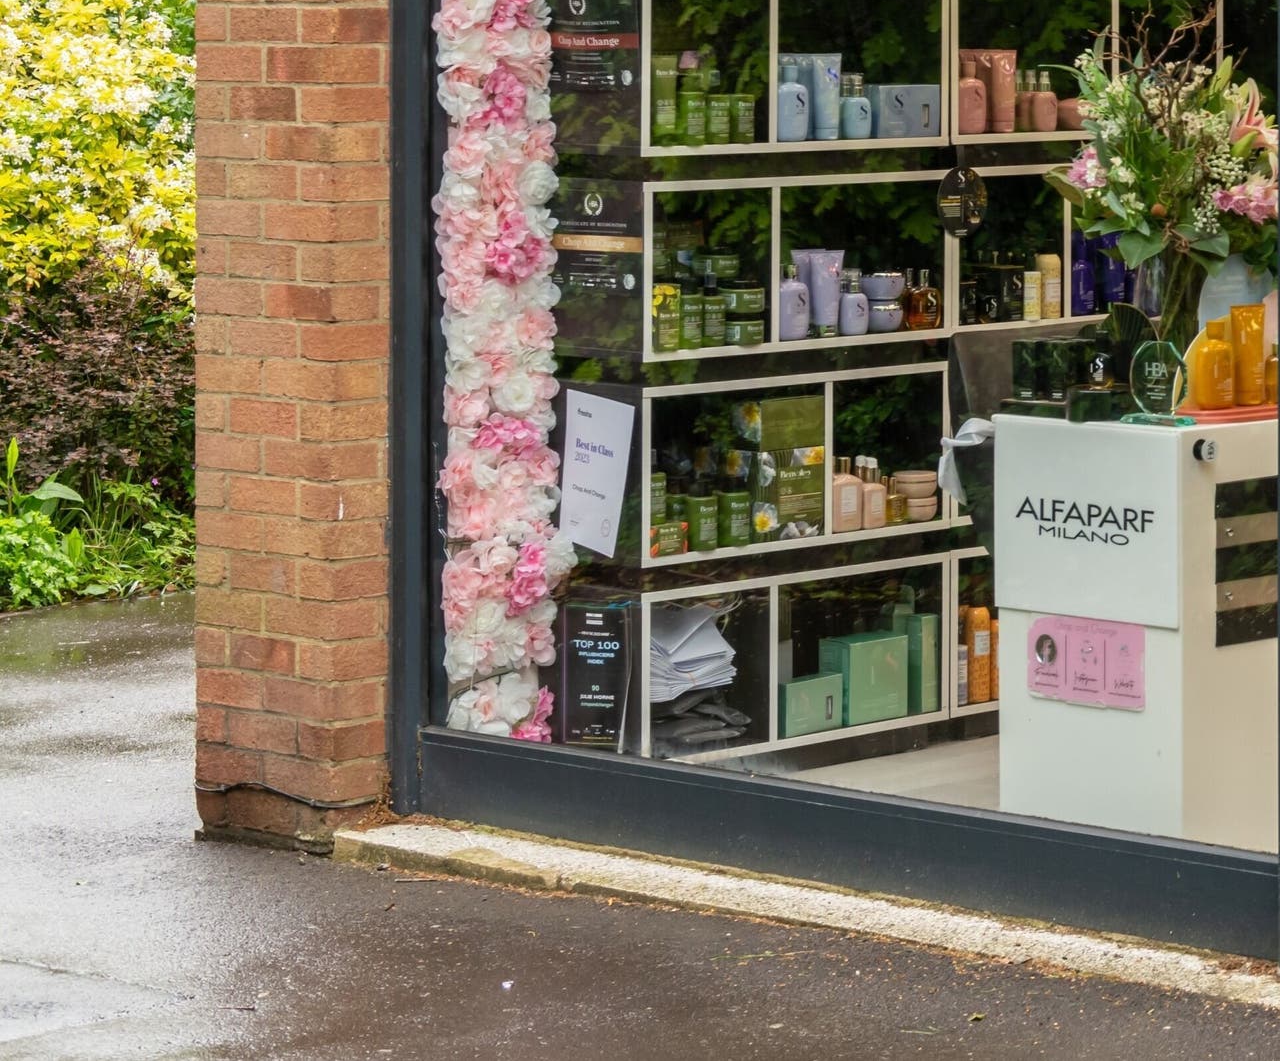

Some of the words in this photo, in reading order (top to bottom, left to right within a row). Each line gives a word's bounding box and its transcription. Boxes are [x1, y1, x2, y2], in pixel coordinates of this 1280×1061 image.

[586, 36, 620, 48] Change
[1145, 361, 1169, 378] HBA
[575, 437, 590, 452] Best
[590, 441, 597, 453] in
[597, 444, 614, 458] Class
[1016, 496, 1155, 533] ALFAPARF
[1038, 524, 1130, 546] MILANO
[573, 639, 595, 649] TOP
[597, 641, 620, 650] 100
